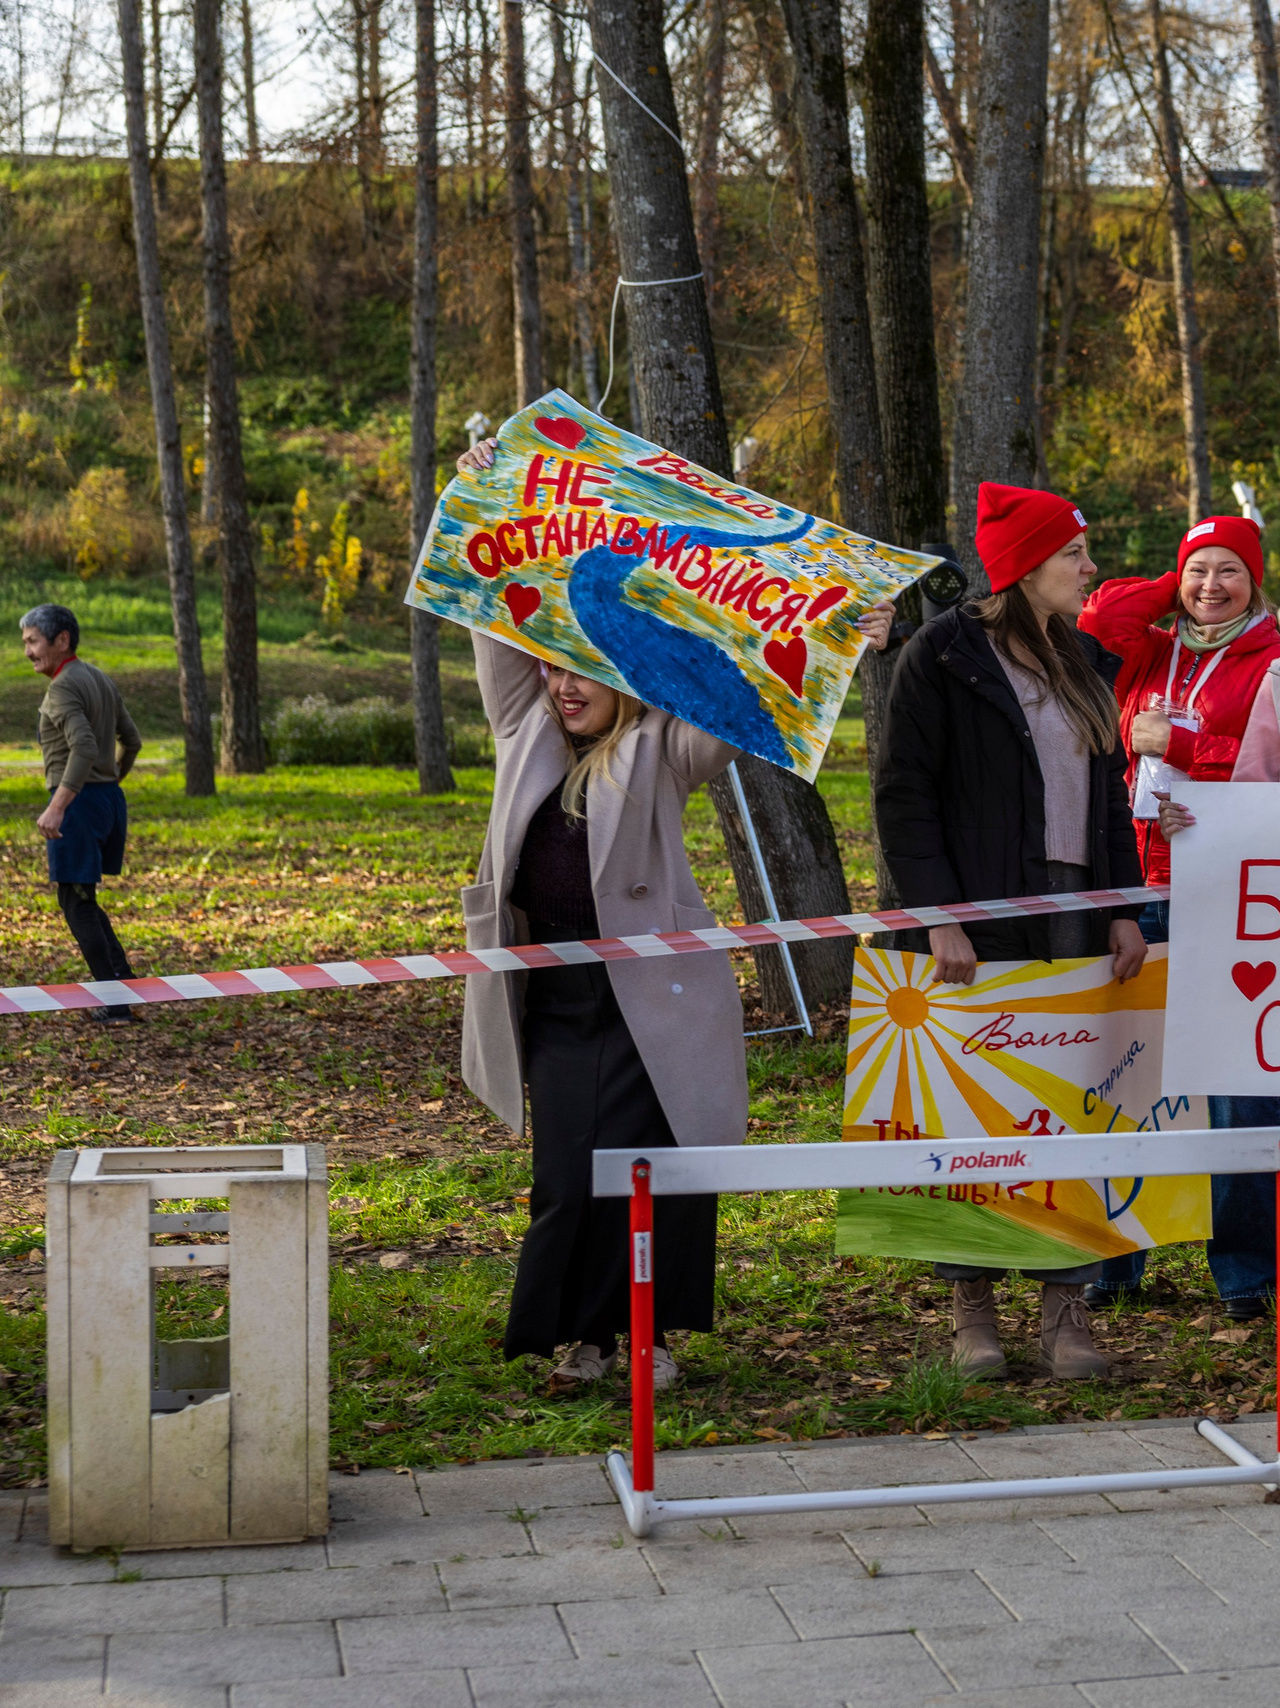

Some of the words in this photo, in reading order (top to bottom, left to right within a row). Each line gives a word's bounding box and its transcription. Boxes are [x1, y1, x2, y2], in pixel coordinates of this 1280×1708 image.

[523, 453, 616, 507] НЕ
[637, 452, 774, 519] Волга
[467, 510, 848, 636] ОСТАНАВЛИВАЙСЯ!
[961, 1012, 1100, 1055] Волга
[949, 1149, 1028, 1174] polanik
